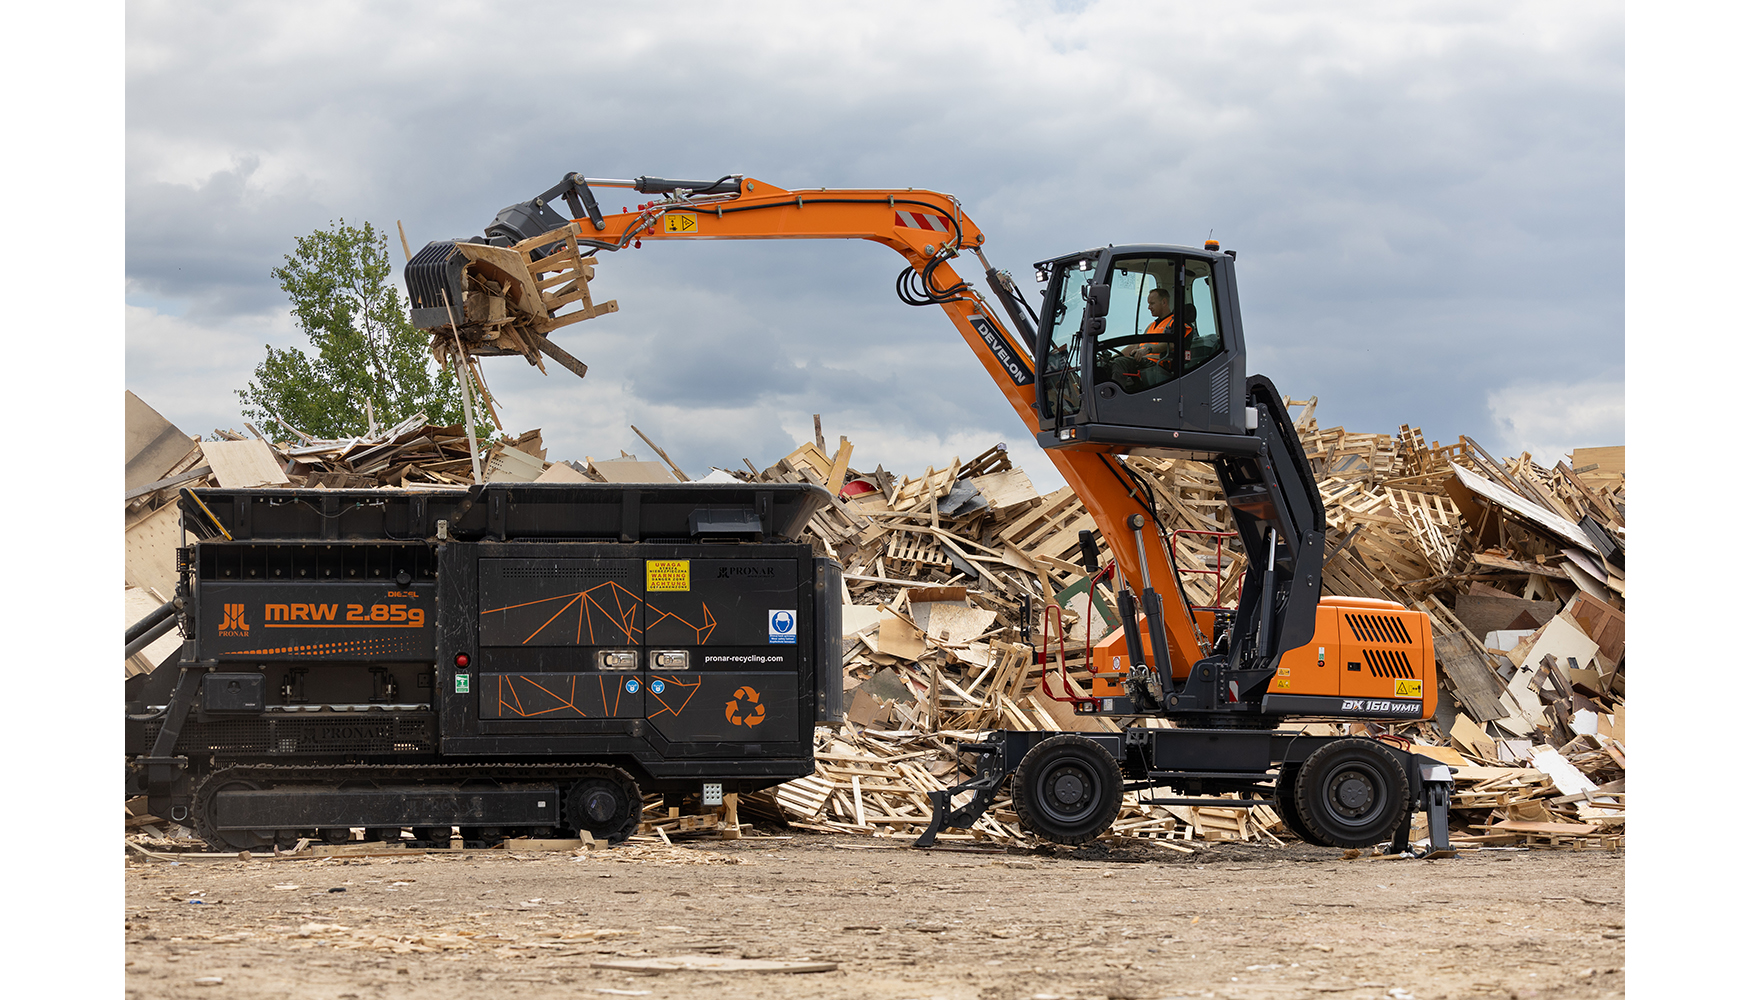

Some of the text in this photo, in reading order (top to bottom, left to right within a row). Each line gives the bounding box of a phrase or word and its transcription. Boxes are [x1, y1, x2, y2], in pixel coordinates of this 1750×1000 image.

[977, 323, 1026, 383] DEVELON
[730, 567, 774, 575] PRONAR
[346, 604, 425, 625] 2.85g
[705, 655, 784, 664] pronar-recycling.com
[1341, 700, 1420, 713] DX 160 WMH
[322, 727, 386, 738] PRONAR
